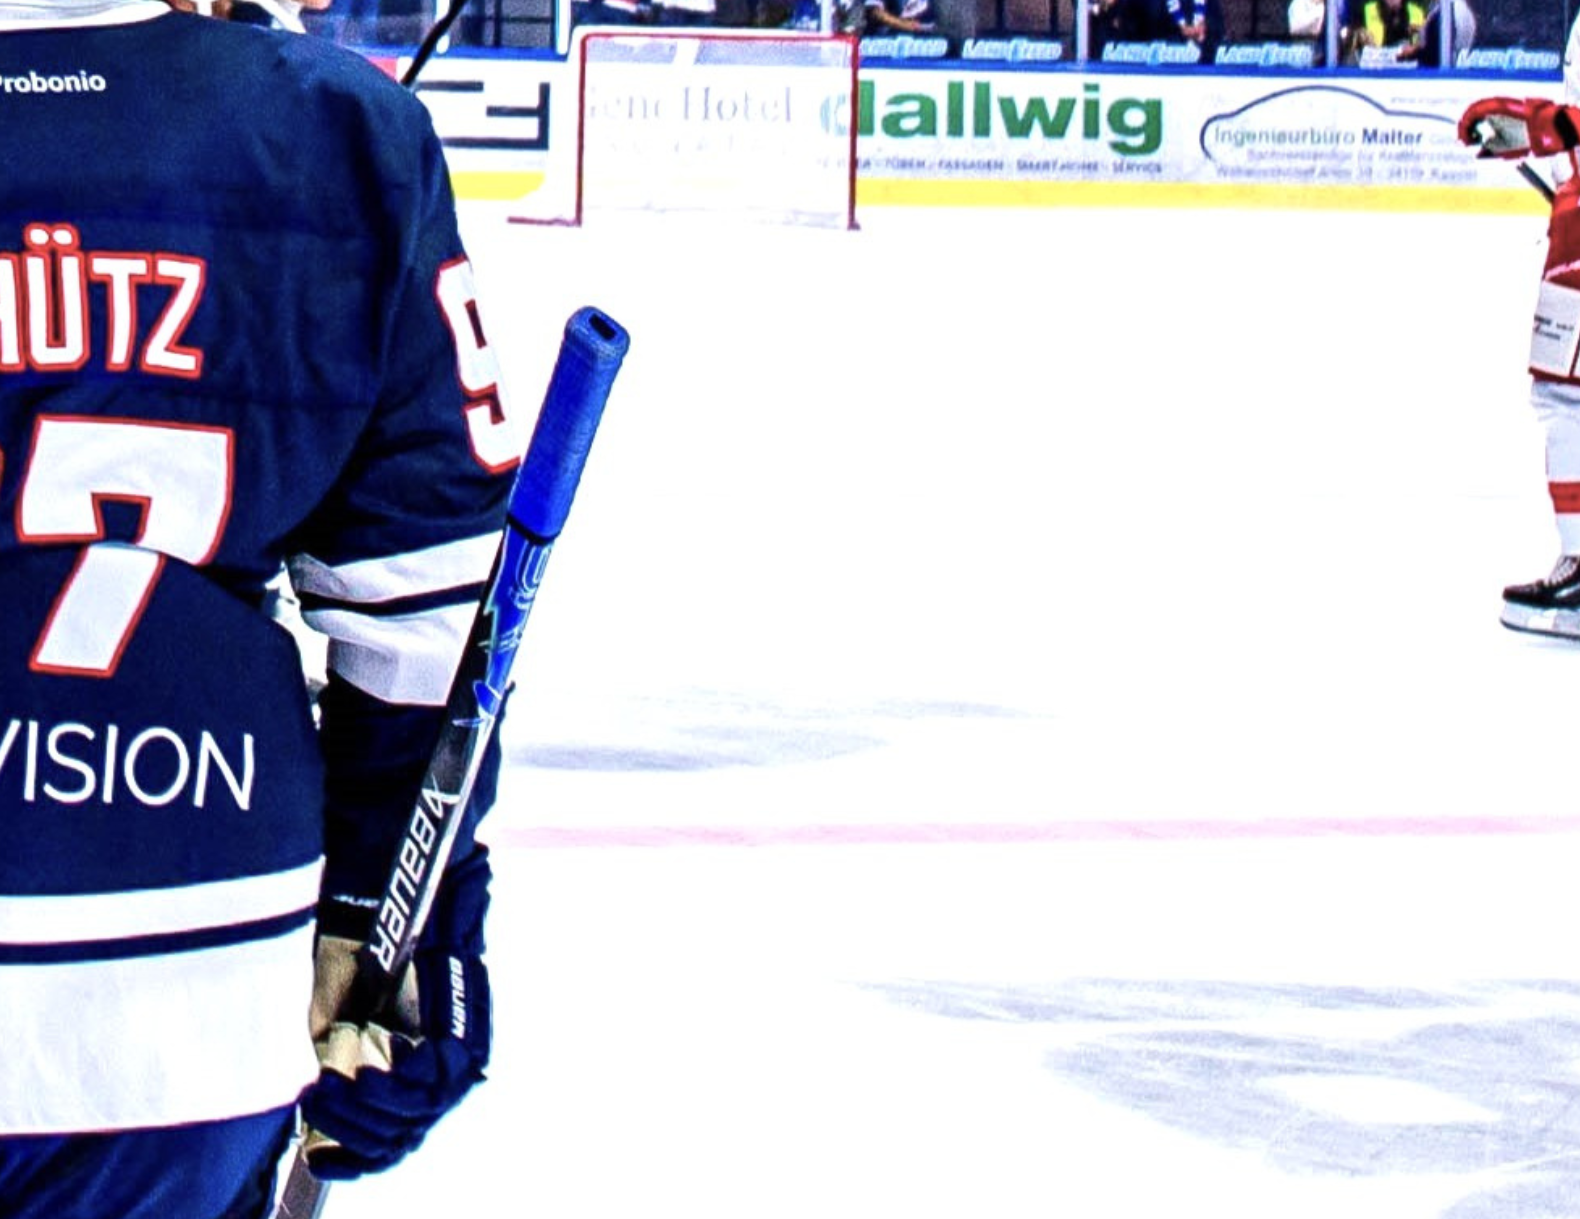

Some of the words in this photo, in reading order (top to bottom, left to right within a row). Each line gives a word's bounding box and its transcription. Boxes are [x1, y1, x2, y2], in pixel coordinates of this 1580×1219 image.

[818, 79, 1162, 156] dallwig
[1213, 124, 1356, 148] Ingenieurbüro
[369, 803, 436, 974] BAUER
